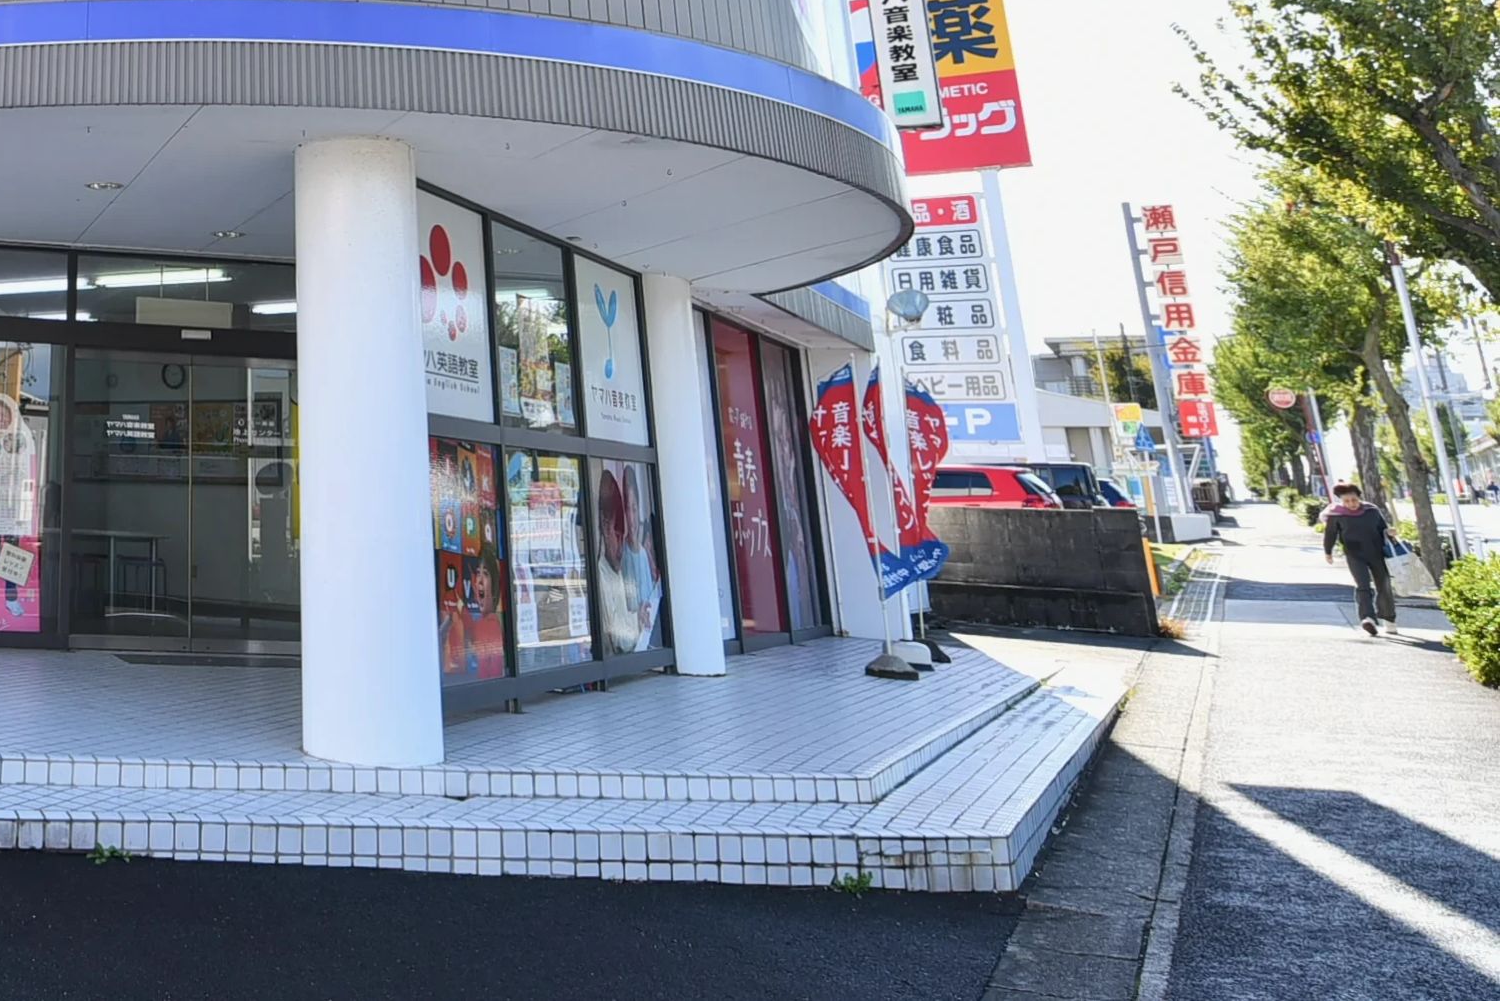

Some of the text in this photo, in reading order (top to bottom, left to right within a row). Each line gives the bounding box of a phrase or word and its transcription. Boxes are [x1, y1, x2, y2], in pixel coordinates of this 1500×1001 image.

[898, 105, 924, 114] YAMAHA
[898, 268, 982, 291] 日用雑貨
[1143, 205, 1208, 396] 瀬戸信用金庫
[937, 304, 988, 326] 粧品
[909, 339, 994, 361] 食料品
[424, 350, 479, 379] ハ英語教室
[916, 375, 999, 396] ベビー用品
[591, 385, 637, 412] ヤマハ音楽教室
